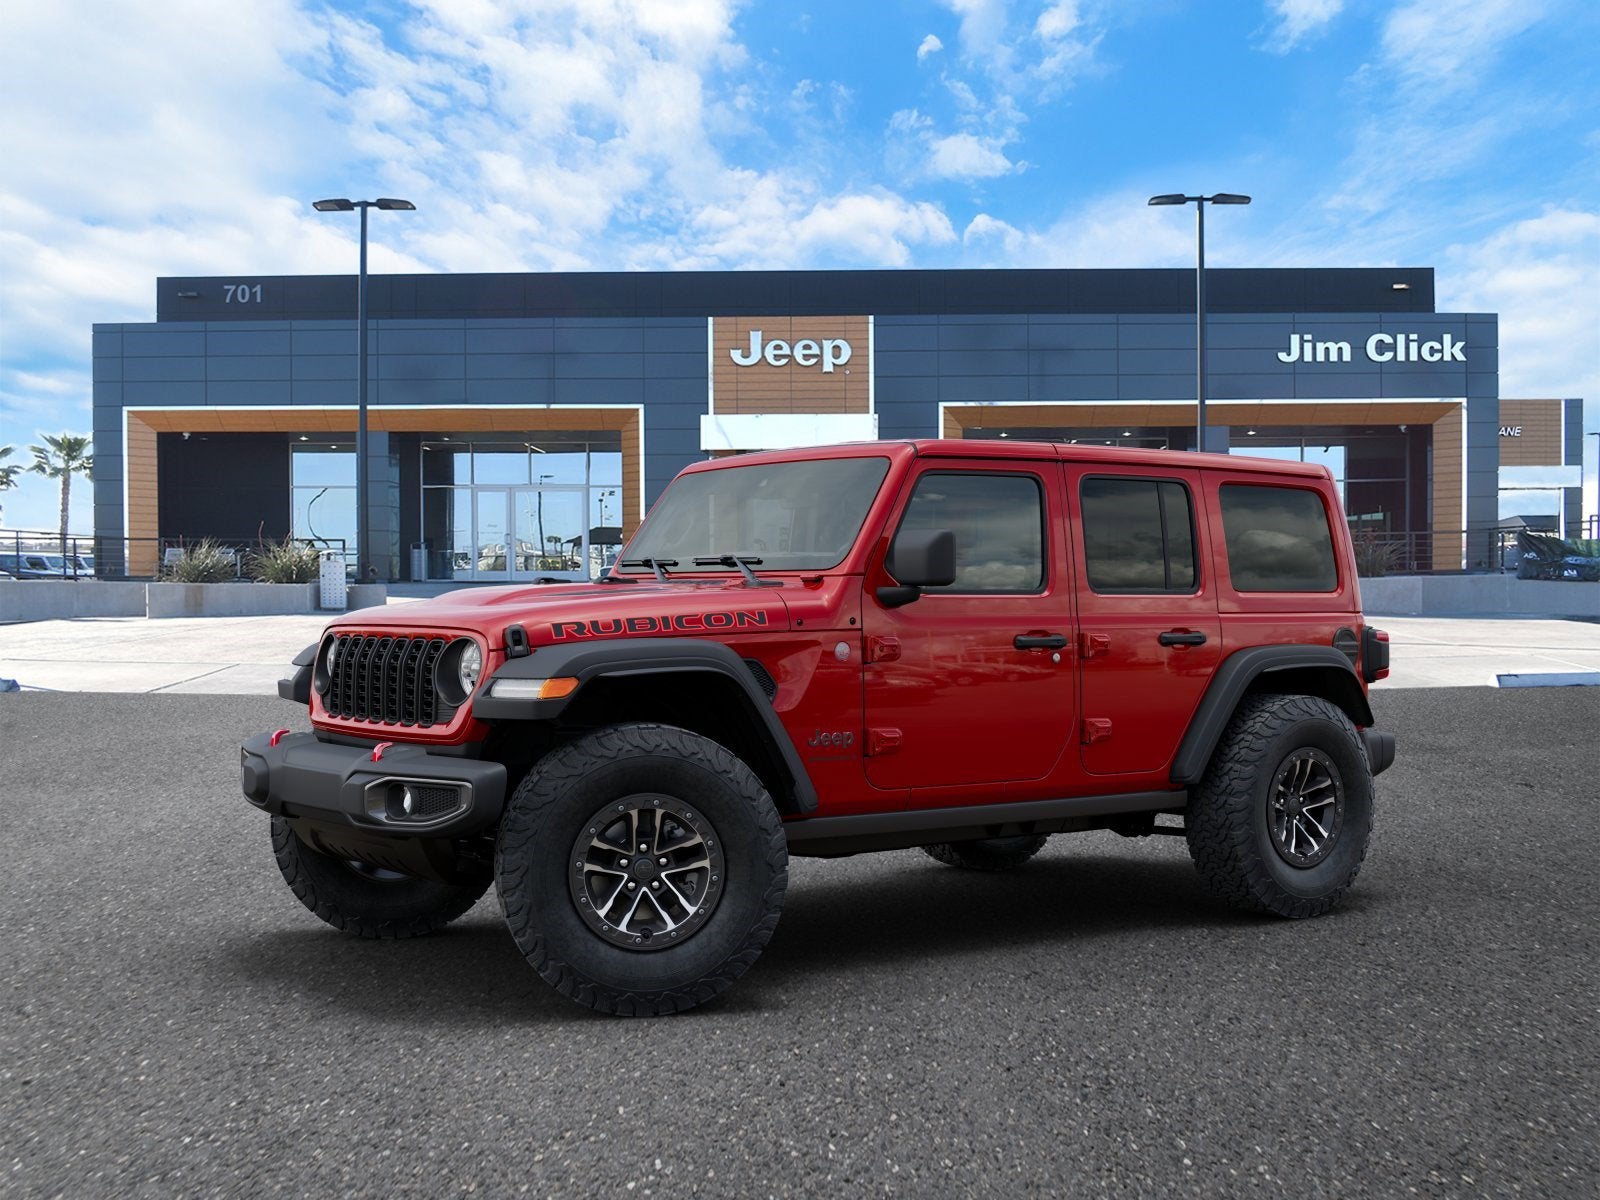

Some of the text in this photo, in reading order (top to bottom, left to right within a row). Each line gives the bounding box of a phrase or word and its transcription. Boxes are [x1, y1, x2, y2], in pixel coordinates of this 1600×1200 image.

[223, 284, 262, 303] 701
[730, 330, 852, 373] Jeep
[1277, 333, 1467, 362] Jim Click
[1498, 426, 1522, 436] ANE
[551, 609, 768, 639] RUBICON
[808, 729, 854, 748] Jeep
